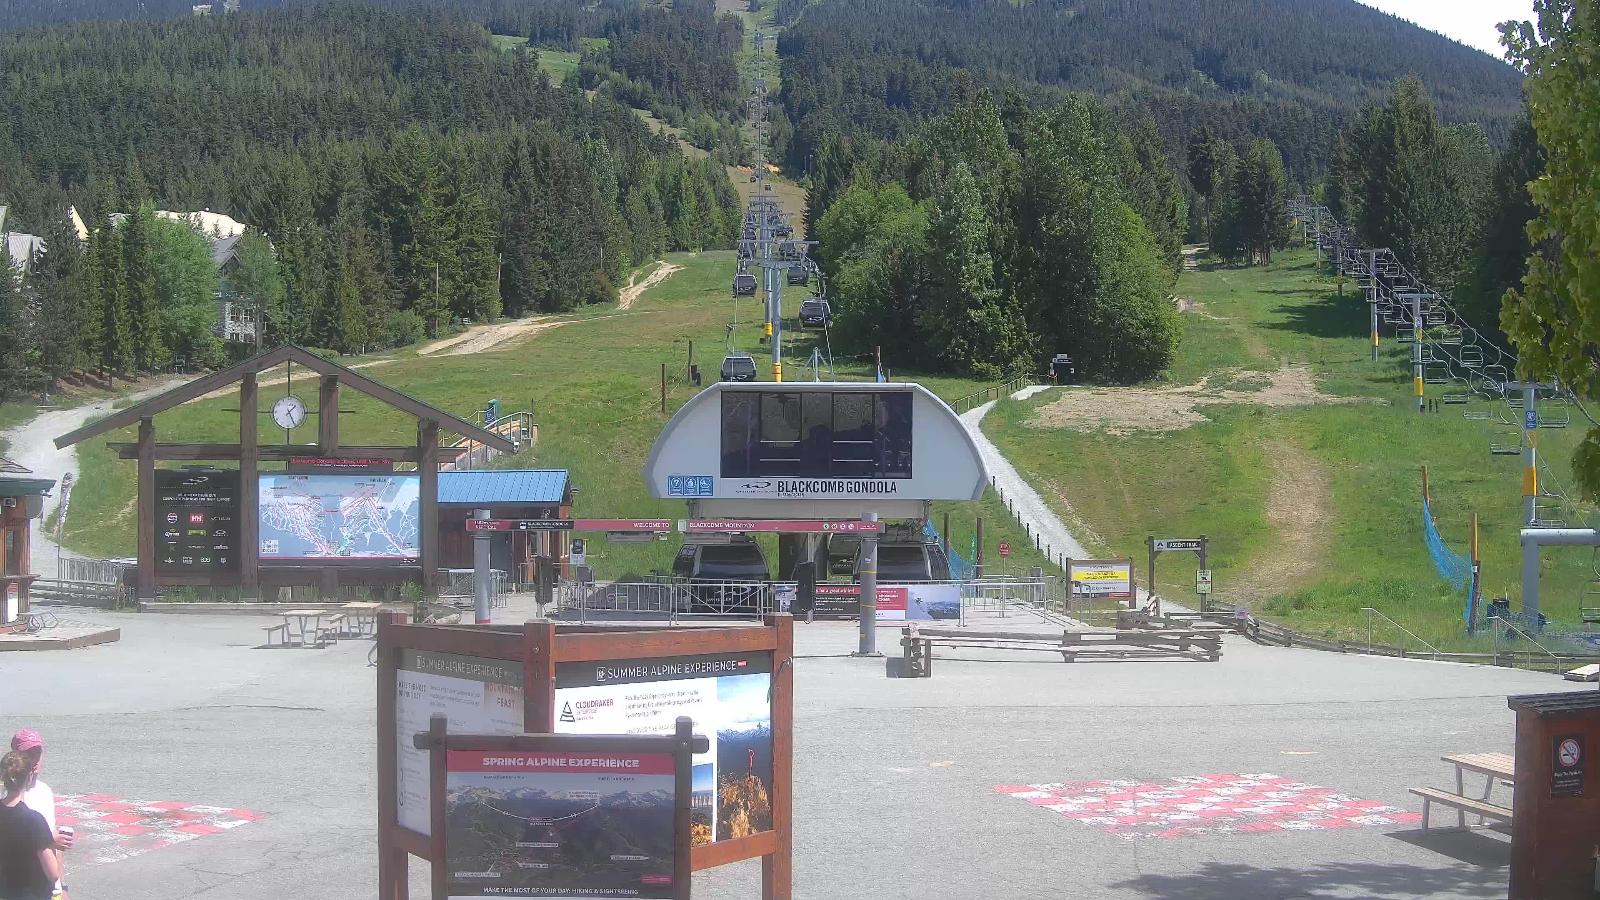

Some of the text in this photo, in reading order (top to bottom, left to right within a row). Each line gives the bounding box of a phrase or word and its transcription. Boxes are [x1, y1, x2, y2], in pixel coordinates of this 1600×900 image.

[777, 480, 897, 493] BLACKCOMB GONDOLA
[607, 660, 737, 679] SUMMER ALPINE EXPERIENCE
[482, 757, 640, 768] SPRING ALPINE EXPERIENCE
